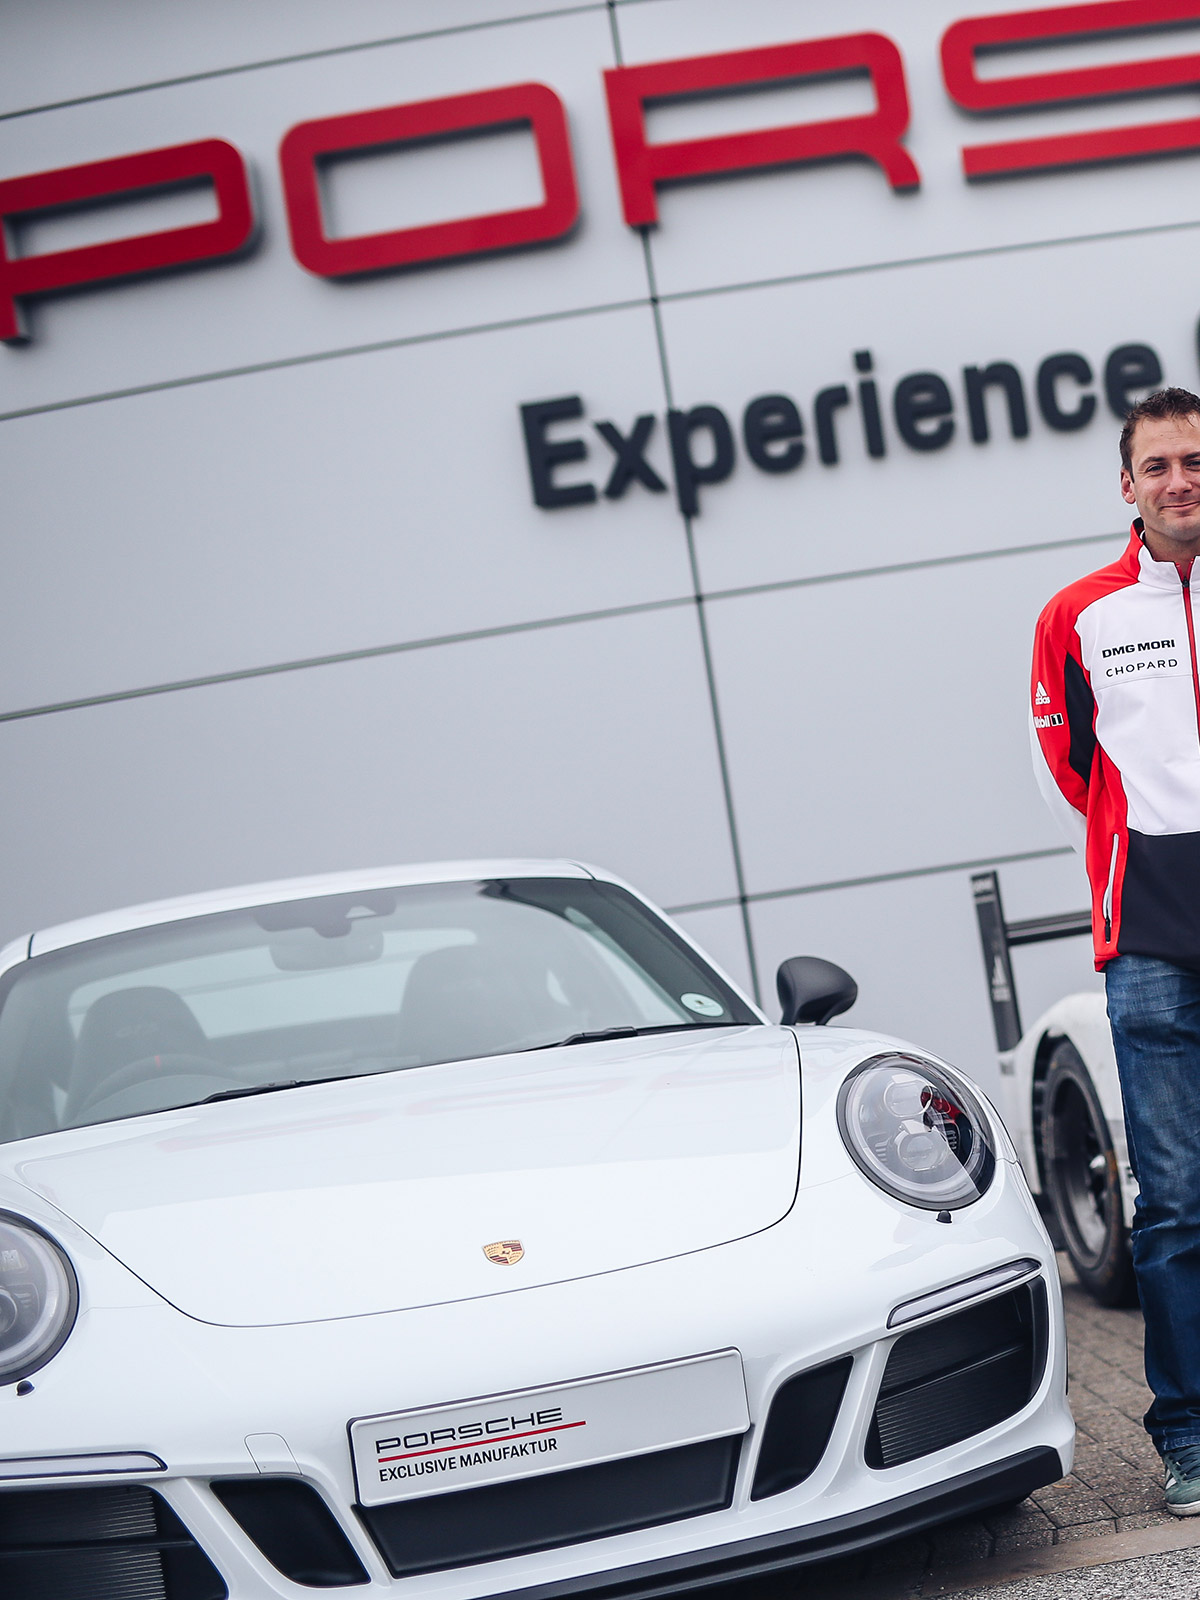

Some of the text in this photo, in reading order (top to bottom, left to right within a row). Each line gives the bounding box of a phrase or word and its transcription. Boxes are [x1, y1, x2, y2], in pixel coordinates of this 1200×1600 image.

[520, 349, 1166, 517] Experience
[1102, 639, 1176, 658] DMG MORI
[1105, 658, 1178, 678] CHOPARD
[375, 1407, 563, 1454] PORSCHE
[379, 1437, 558, 1482] EXCLUSIVE MANUFAKTUR
